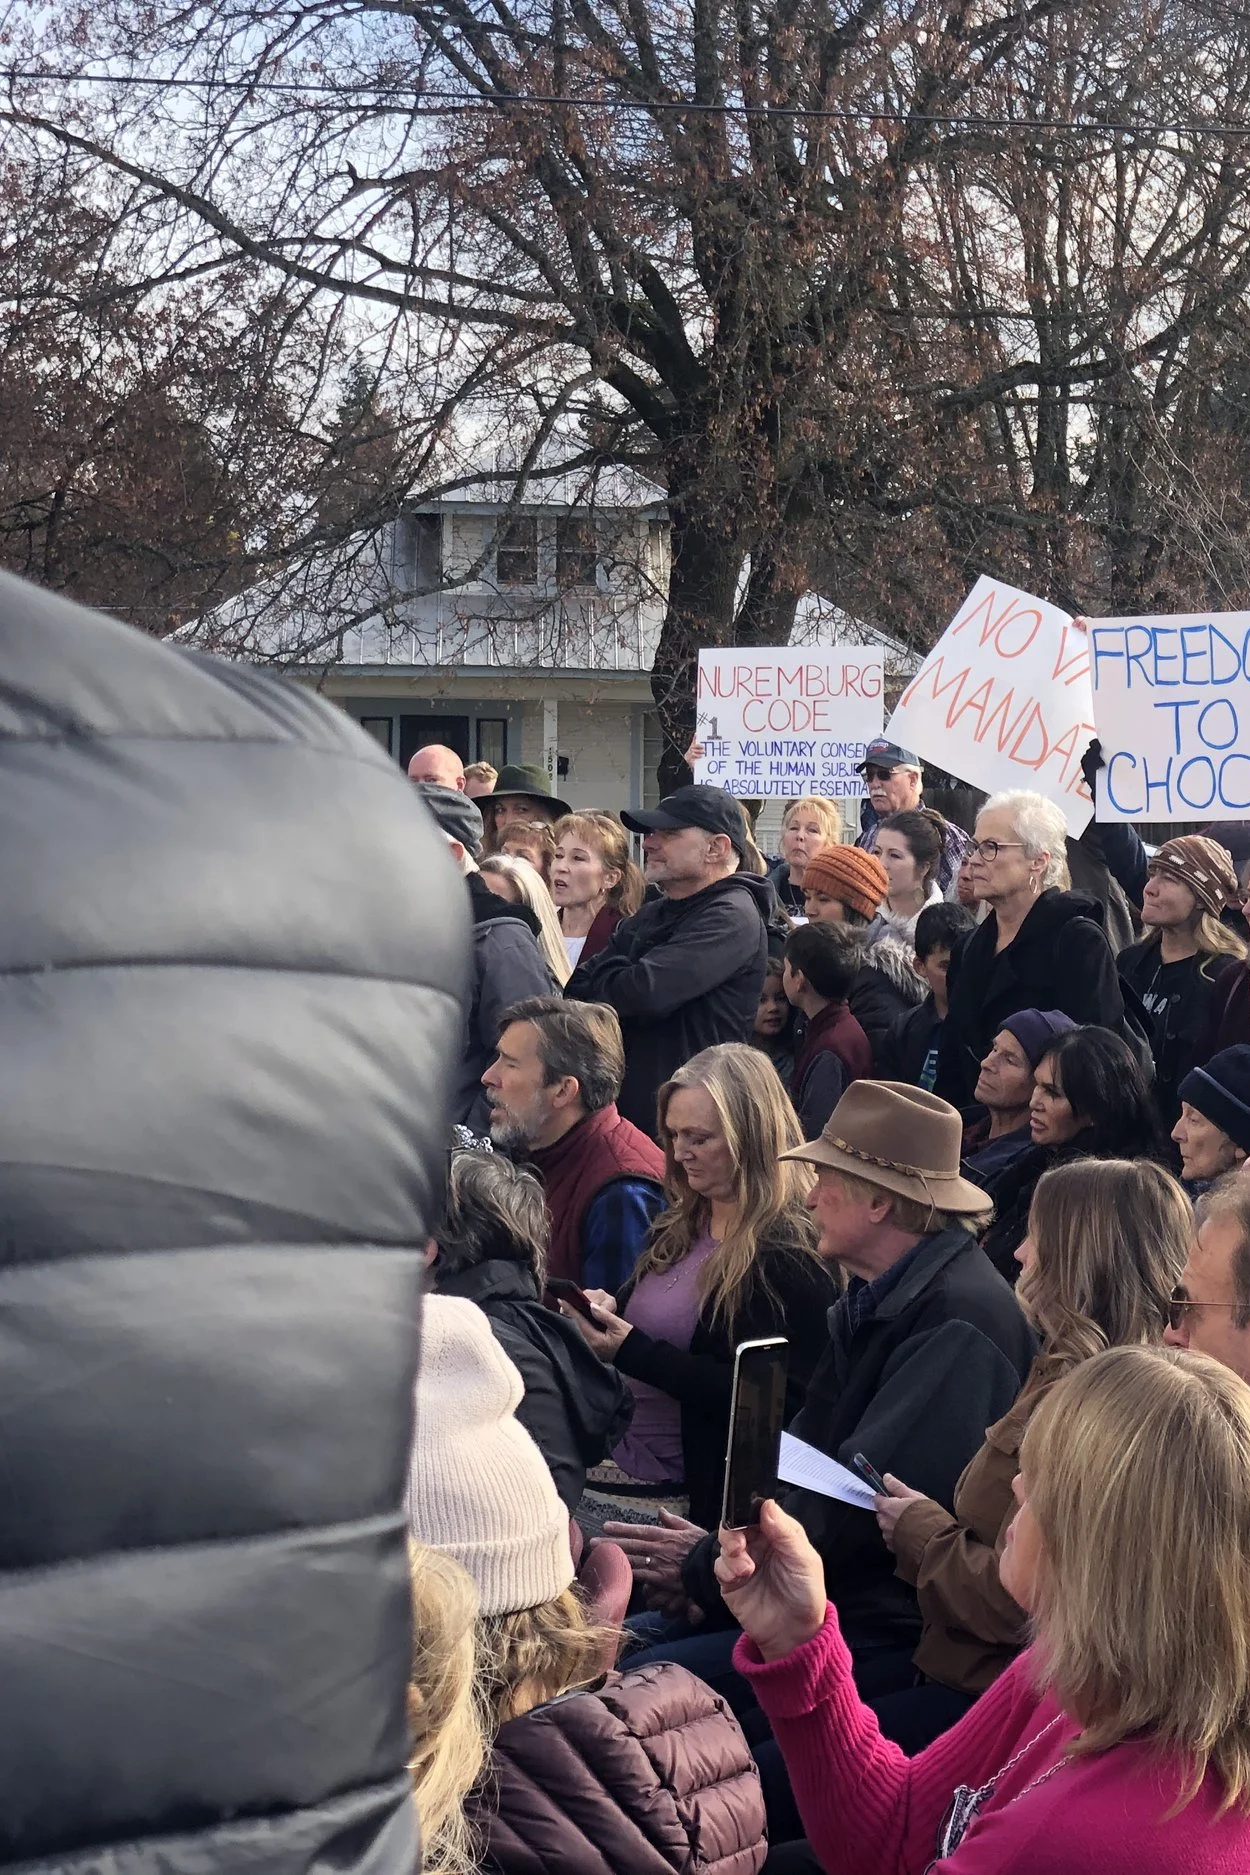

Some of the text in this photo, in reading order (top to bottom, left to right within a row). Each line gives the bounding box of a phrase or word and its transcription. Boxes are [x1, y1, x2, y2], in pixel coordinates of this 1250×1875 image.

[952, 590, 1042, 658] NO
[699, 664, 882, 699] NUREMBURG
[697, 712, 722, 740] #1
[742, 699, 832, 733] CODE
[1153, 698, 1238, 755] TO
[700, 740, 731, 757] THE
[738, 740, 817, 757] VOLUNTARY
[821, 742, 871, 759] CONSEN
[707, 760, 860, 777] OF THE HUMAN SUBJE
[723, 779, 806, 796] ABSOLUTELY
